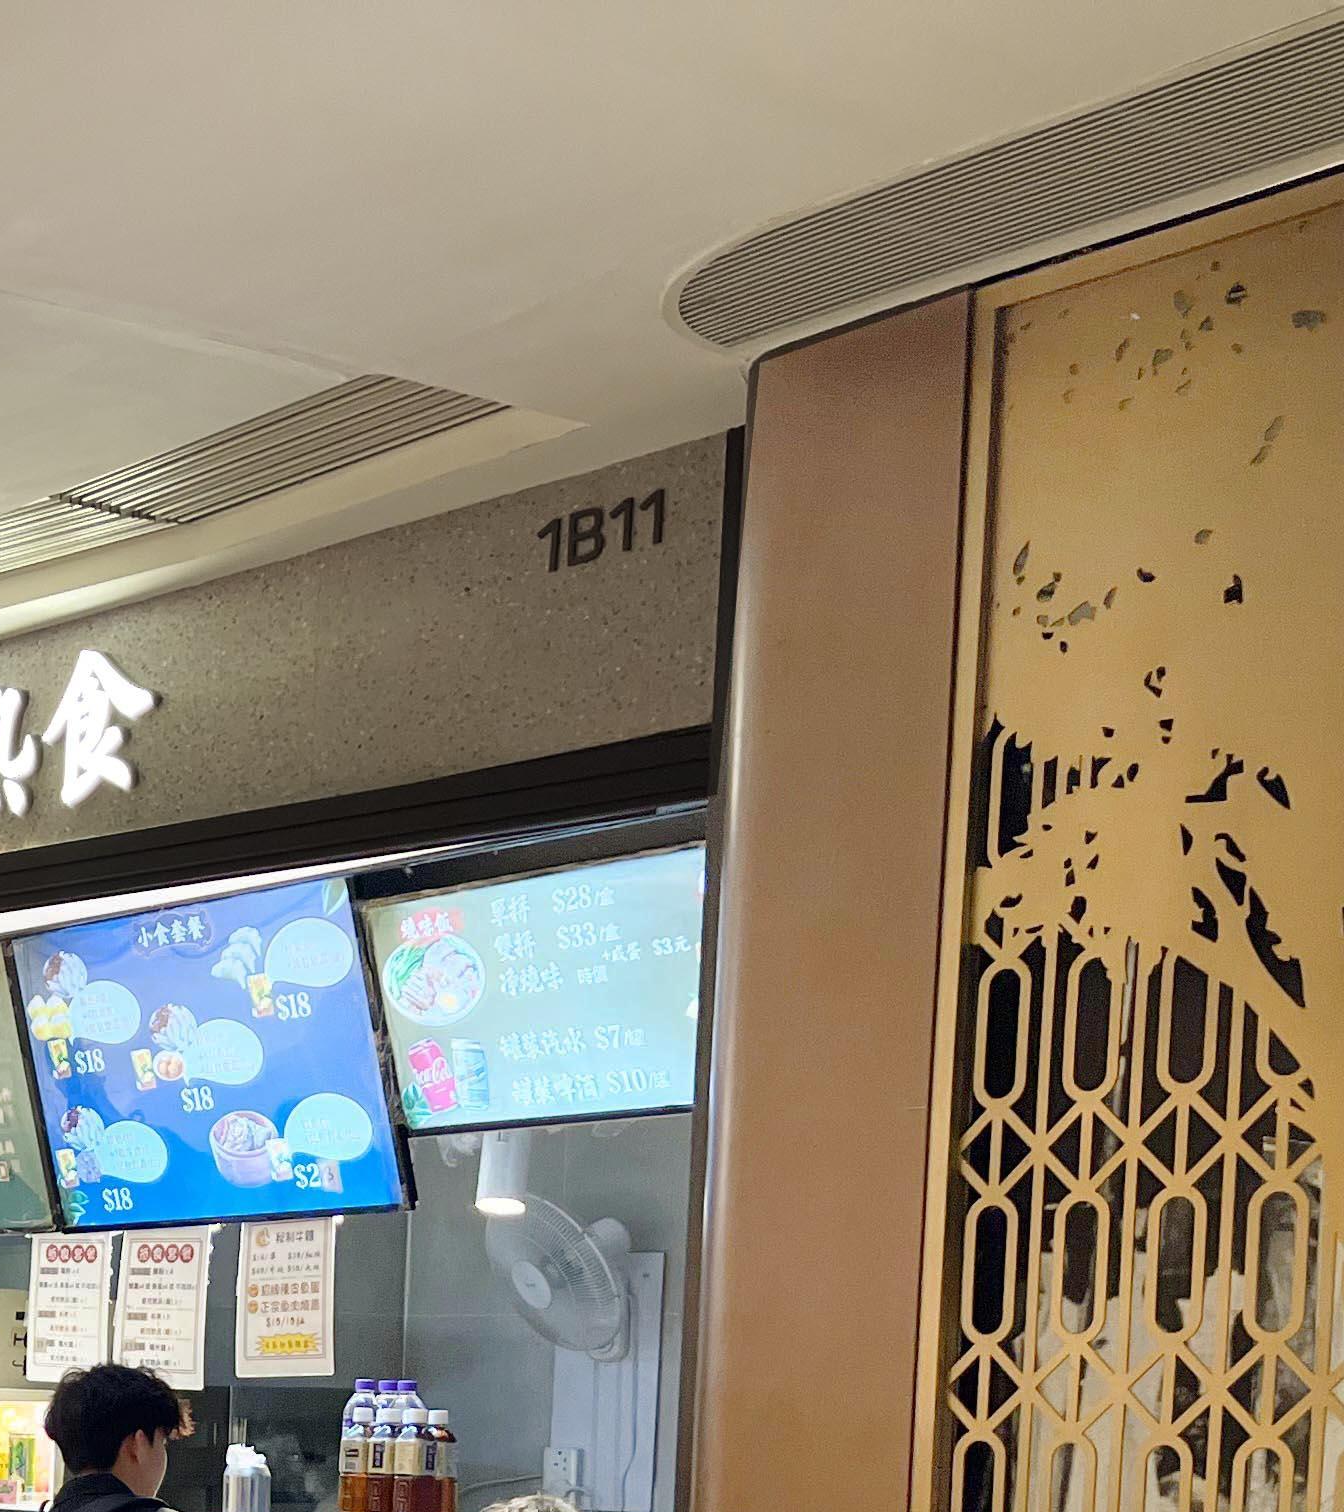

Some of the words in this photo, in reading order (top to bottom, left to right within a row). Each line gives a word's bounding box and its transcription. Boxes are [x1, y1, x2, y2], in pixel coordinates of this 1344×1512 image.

[537, 488, 666, 573] 1B11
[275, 991, 313, 1020] $18
[73, 1047, 106, 1075] $18
[180, 1085, 215, 1113] $18
[102, 1186, 135, 1212] $18
